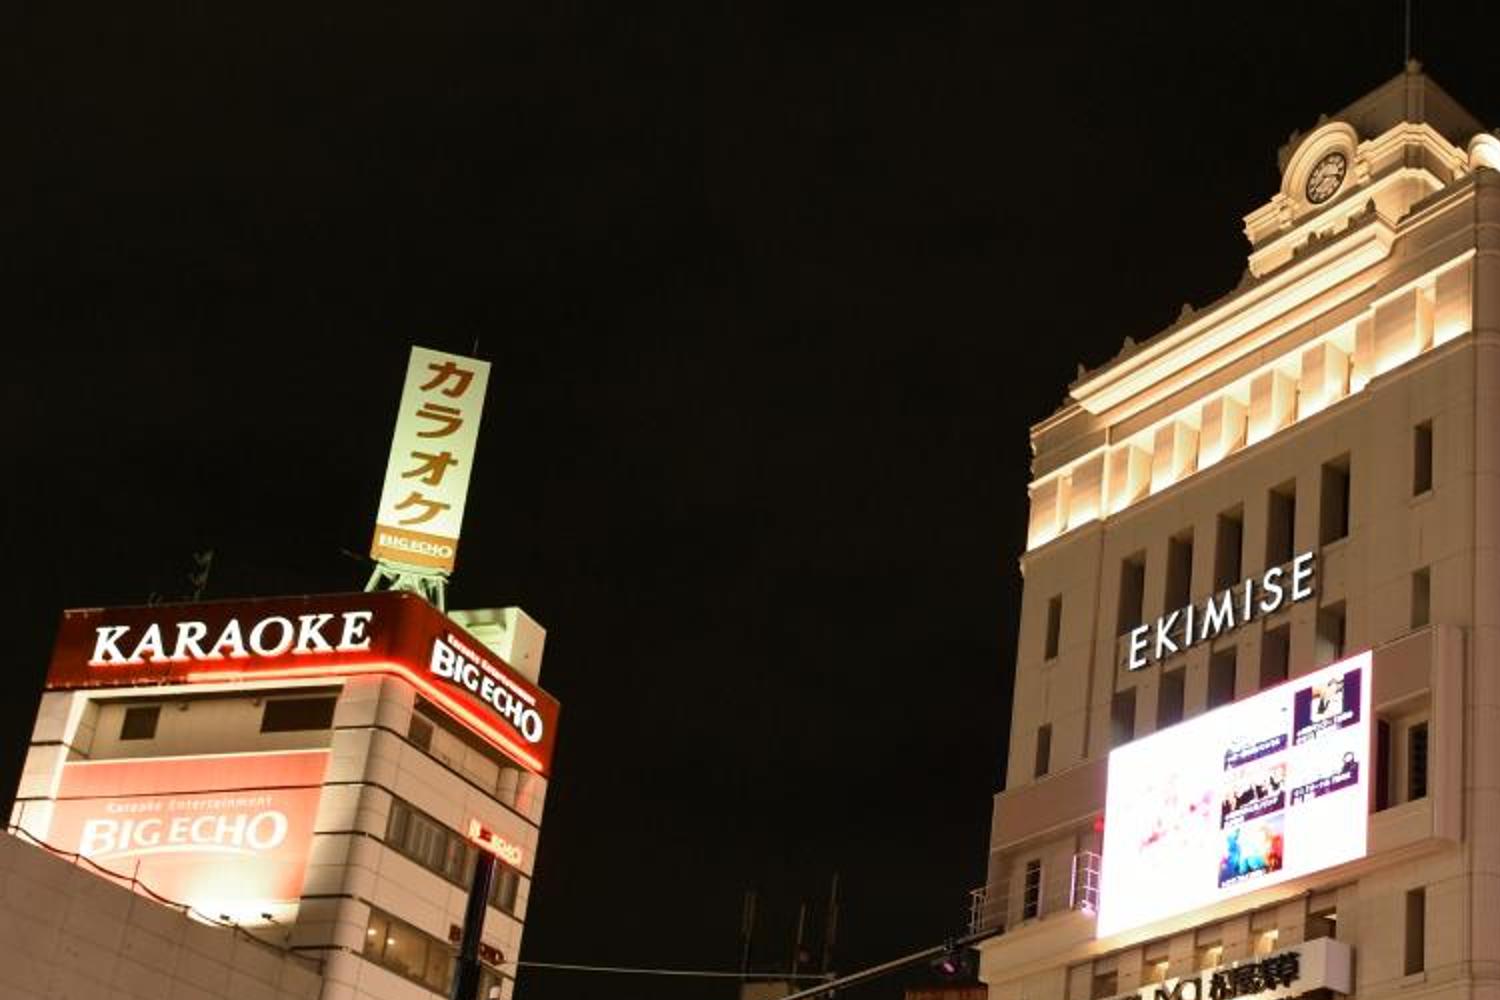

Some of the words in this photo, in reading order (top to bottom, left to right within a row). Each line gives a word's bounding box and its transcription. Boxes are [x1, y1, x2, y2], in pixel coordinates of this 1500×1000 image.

[394, 361, 475, 525] カラオケ
[87, 610, 374, 667] KARAOKE
[1128, 551, 1314, 671] EKIMISE
[430, 637, 481, 693] BIG
[481, 675, 544, 743] ECHO
[79, 817, 163, 858] BIG
[167, 809, 289, 851] ECHO
